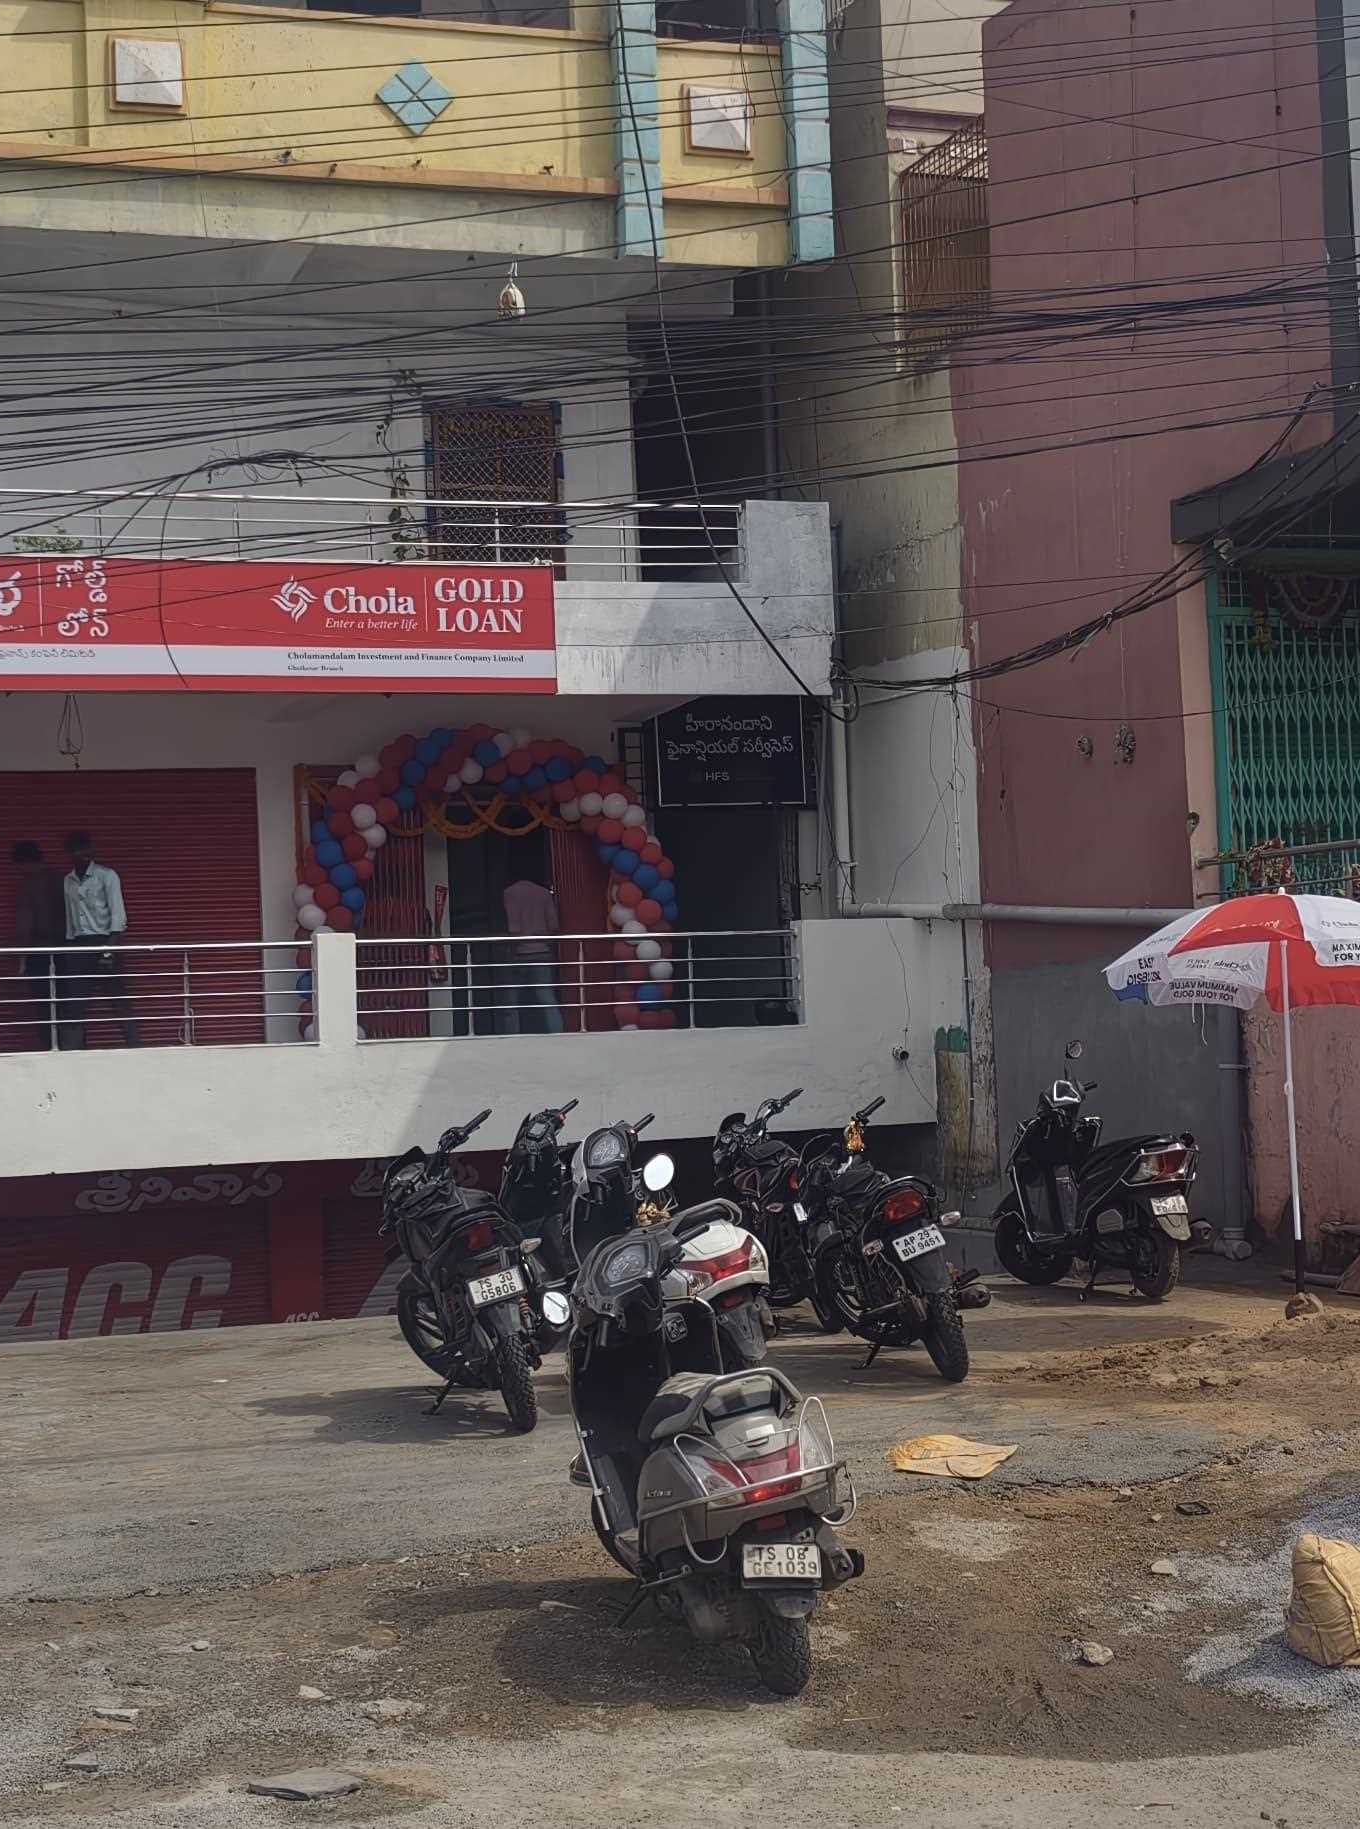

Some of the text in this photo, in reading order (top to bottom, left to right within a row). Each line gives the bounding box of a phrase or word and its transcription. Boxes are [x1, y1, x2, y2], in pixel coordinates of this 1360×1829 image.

[434, 577, 524, 603] GOLD
[323, 586, 417, 615] Chola
[325, 618, 418, 630] Enter a better life
[436, 608, 523, 633] LOAN
[357, 652, 402, 661] Investment
[403, 653, 420, 661] and
[454, 653, 491, 664] Company
[705, 771, 730, 781] HFS
[1334, 953, 1353, 962] FOR
[903, 1236, 915, 1247] AP
[752, 1546, 807, 1561] TS 08
